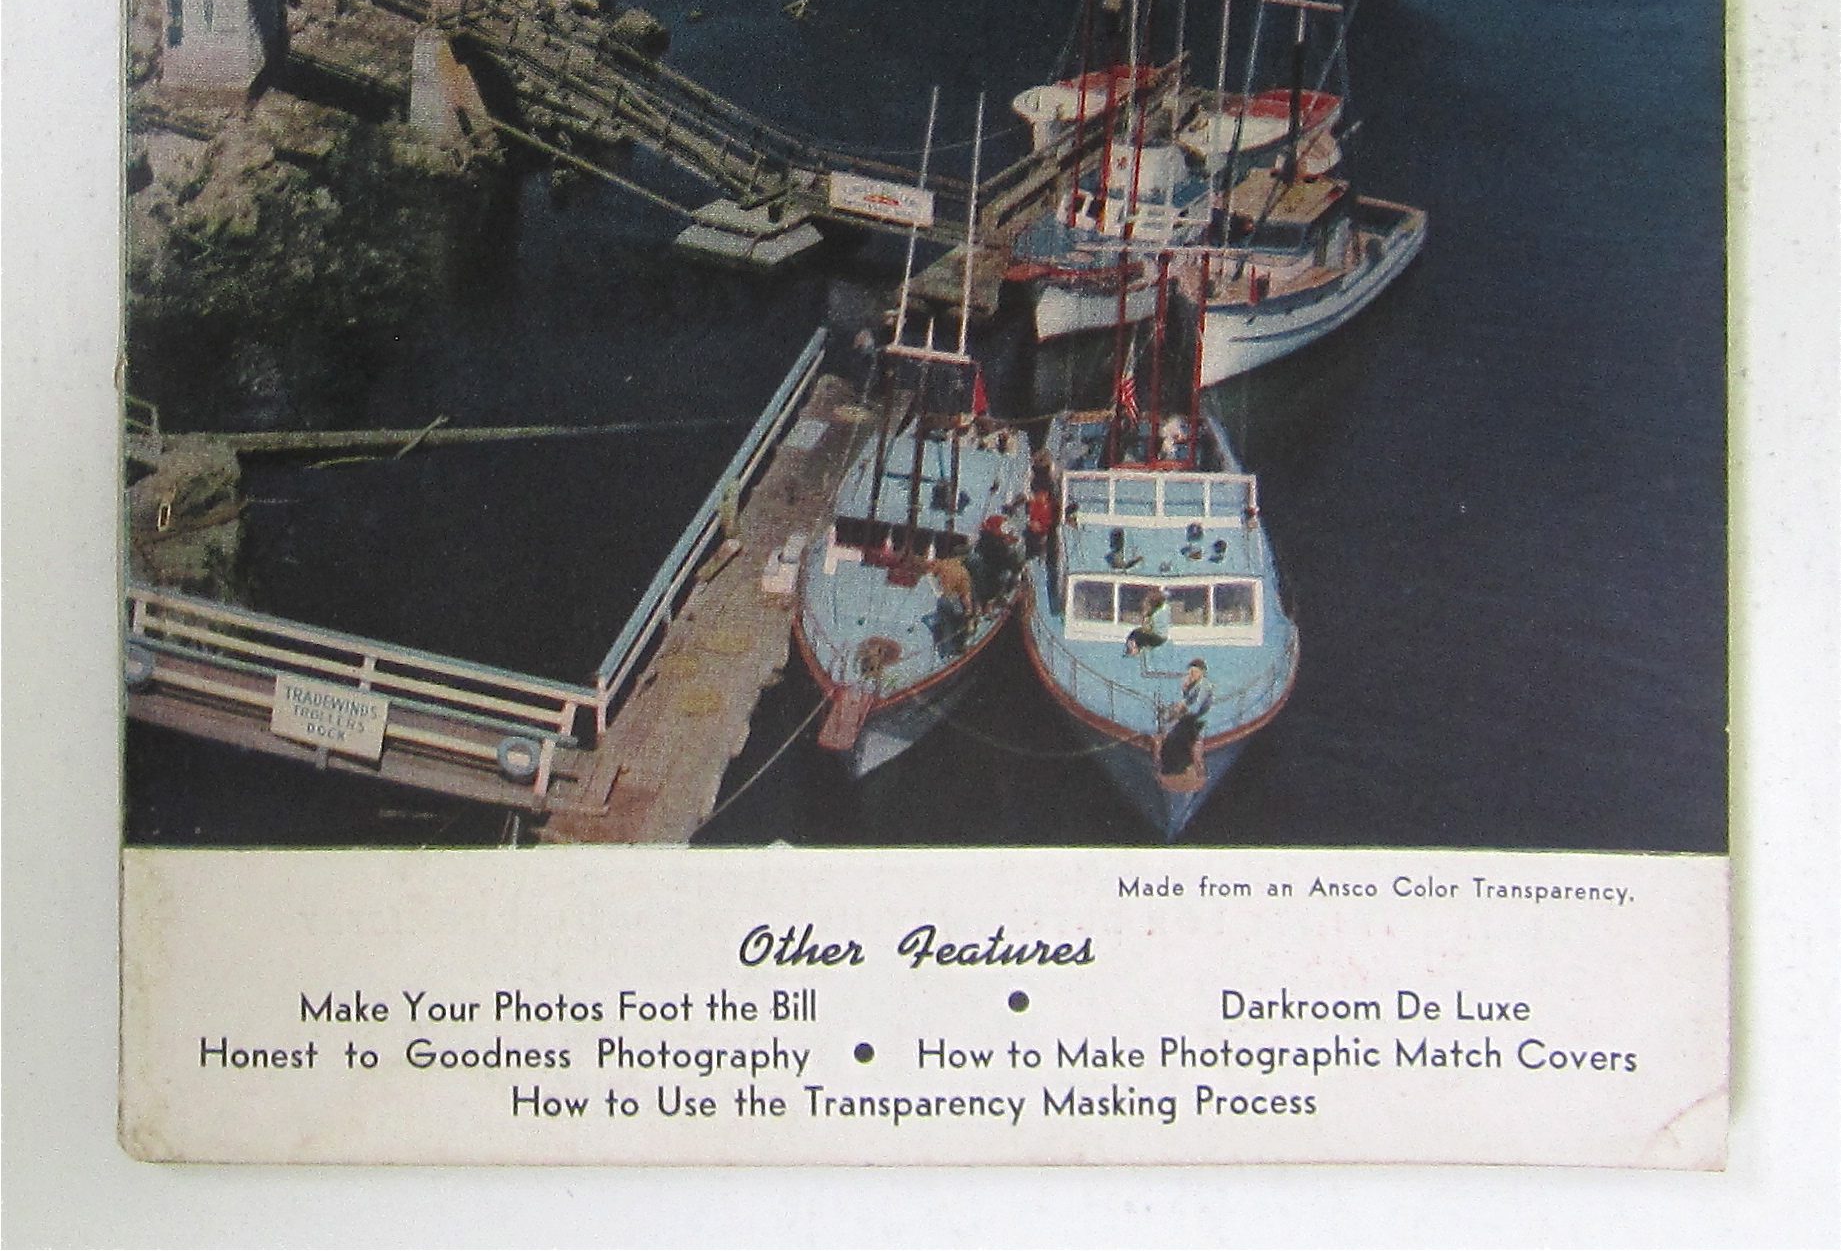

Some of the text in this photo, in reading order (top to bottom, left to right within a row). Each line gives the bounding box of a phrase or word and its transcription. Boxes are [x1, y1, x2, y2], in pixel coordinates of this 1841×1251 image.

[306, 722, 346, 741] DOCK
[1119, 876, 1634, 905] Made from an Ansco Color Transparency.
[740, 924, 1095, 968] Other Features
[301, 988, 815, 1022] Make Your Photos Foot the Bill
[1222, 988, 1530, 1021] Darkroom De Luxe
[201, 1036, 809, 1078] Honest to Goodness Photography
[919, 1035, 1636, 1075] How to Make Photographic Match Covers
[513, 1084, 1316, 1126] How to Use the Transparency Masking Process
